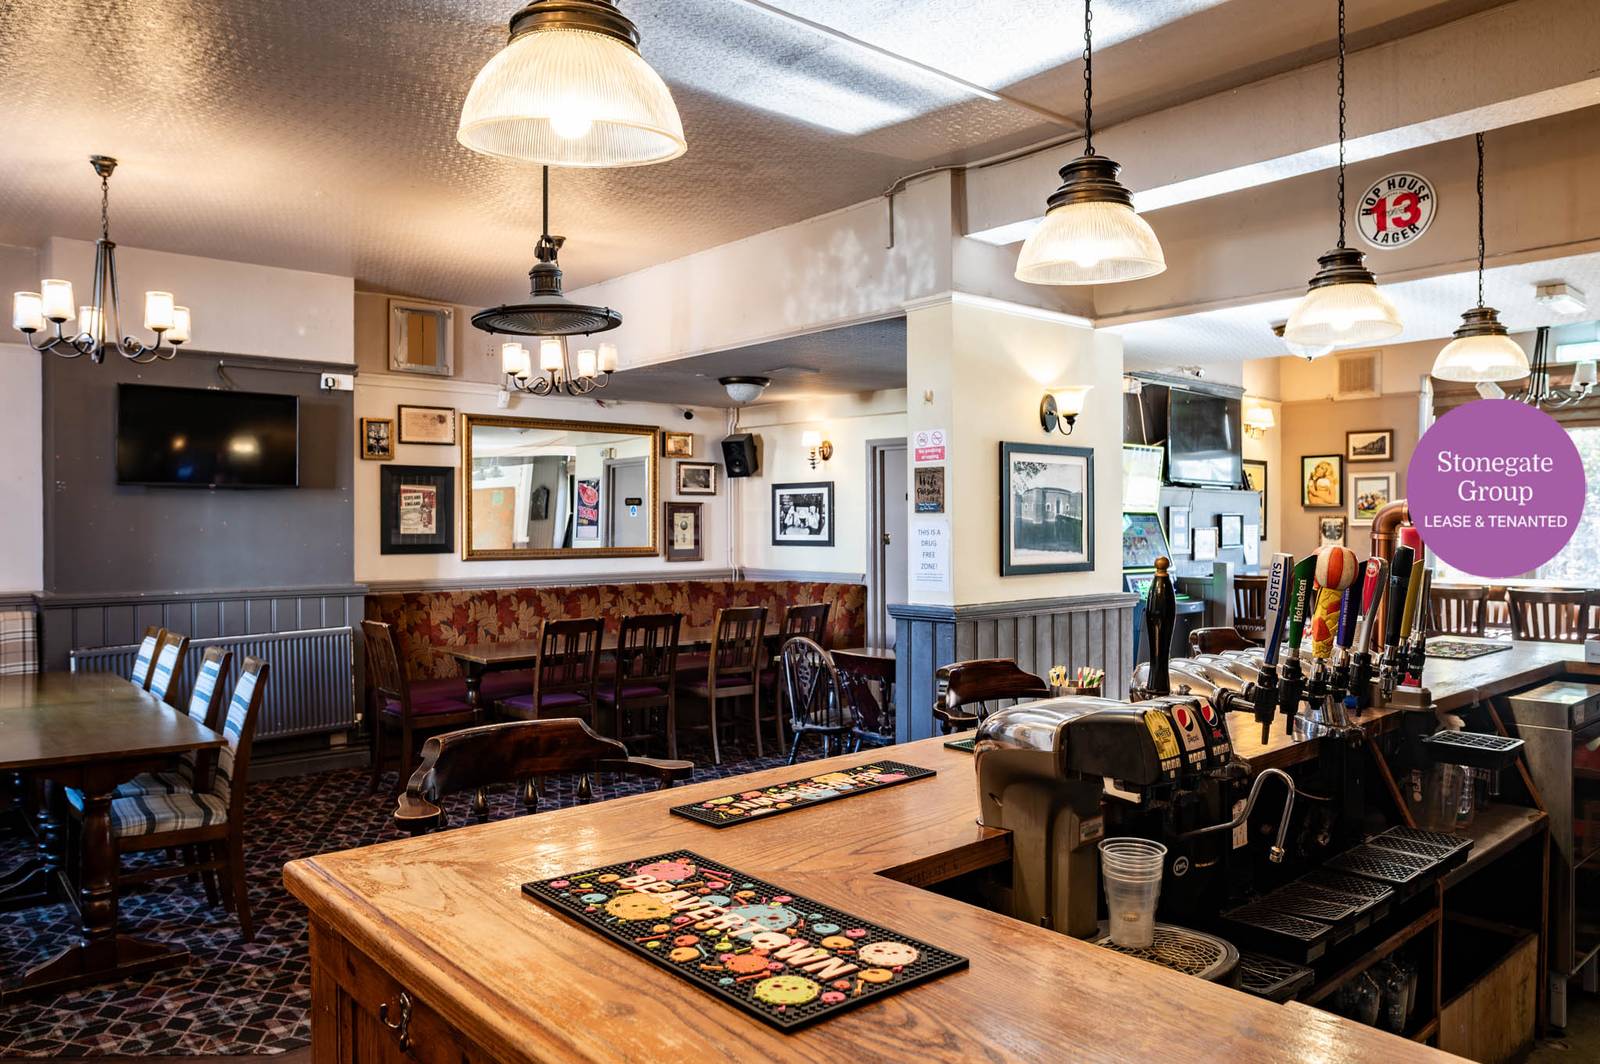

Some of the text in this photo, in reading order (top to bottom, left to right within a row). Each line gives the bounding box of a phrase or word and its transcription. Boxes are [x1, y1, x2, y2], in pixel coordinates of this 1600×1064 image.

[1362, 187, 1382, 216] HOP
[1388, 176, 1430, 204] HOUSE
[1370, 192, 1422, 232] 13
[1373, 224, 1420, 244] LAGER
[1268, 562, 1282, 612] FOSTER'S
[1292, 578, 1306, 623] Heineken
[614, 873, 860, 980] BEAVERTOWN
